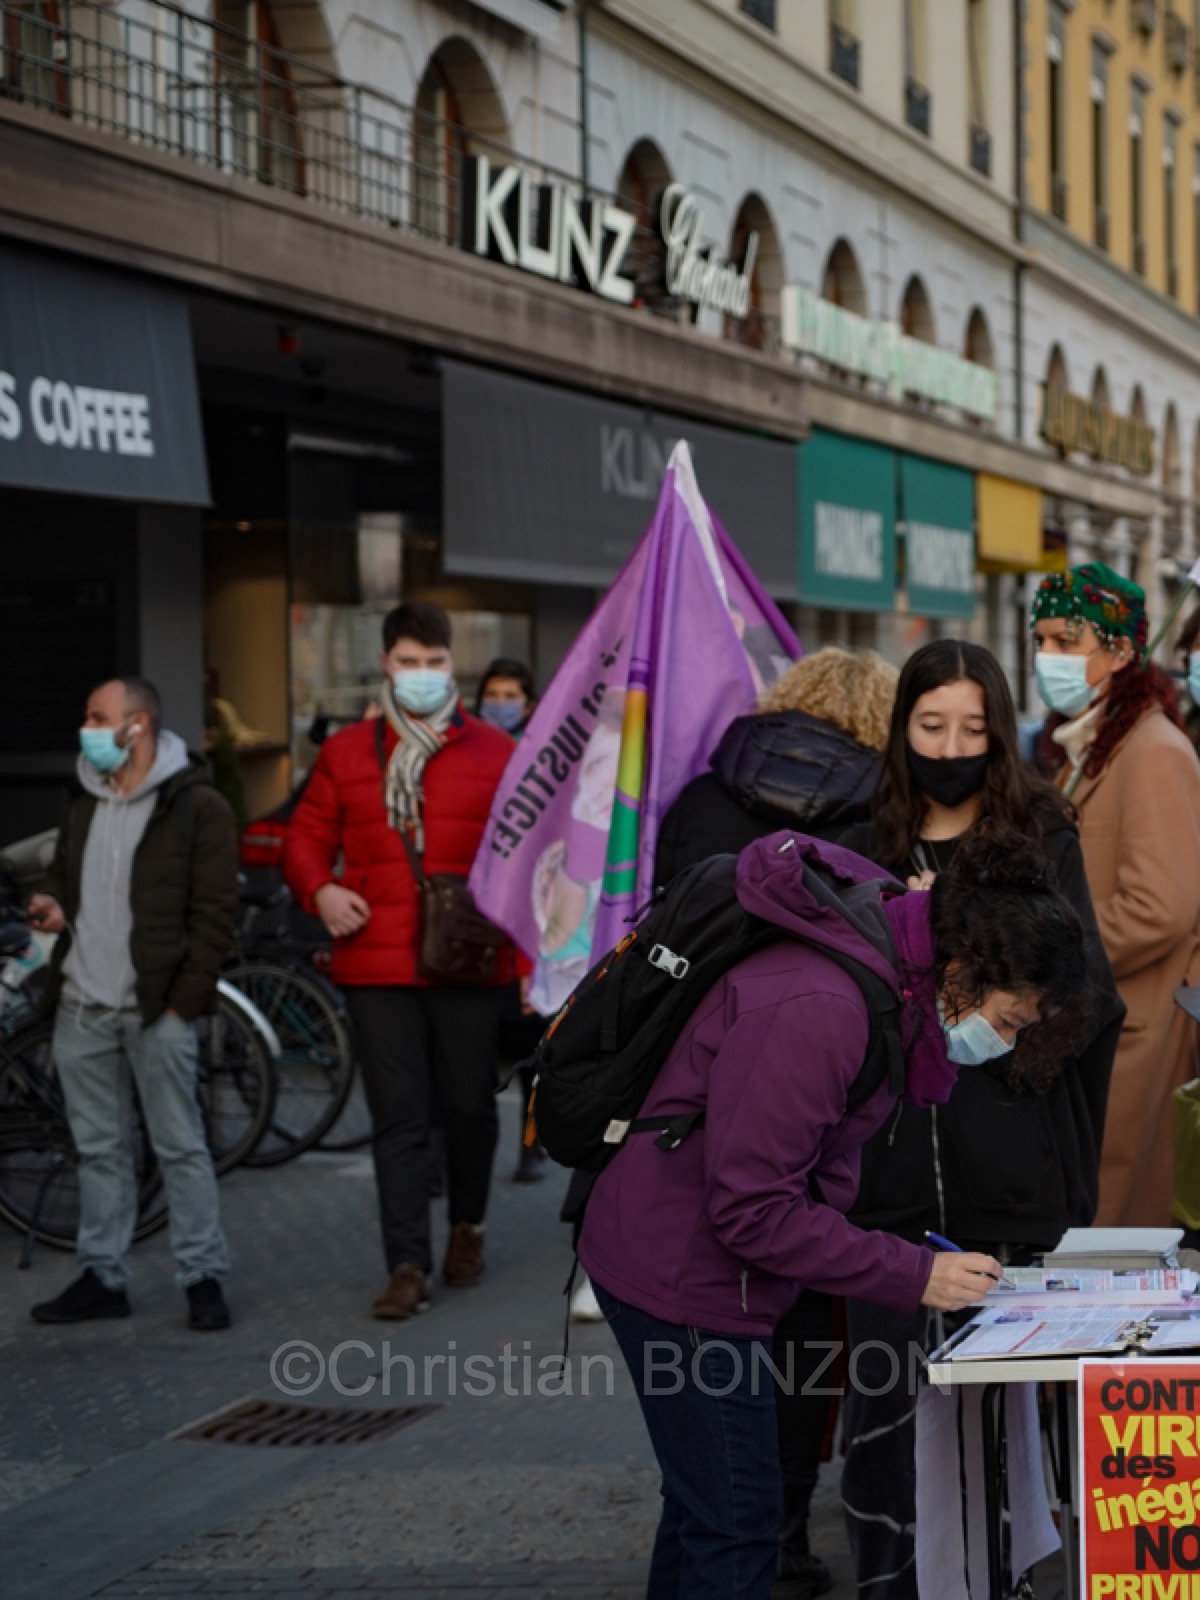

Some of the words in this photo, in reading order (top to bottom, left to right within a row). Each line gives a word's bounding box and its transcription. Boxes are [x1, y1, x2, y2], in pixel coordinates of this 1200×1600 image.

[477, 155, 637, 305] KUNZ
[30, 375, 154, 457] COFFEE
[602, 423, 694, 500] KUN
[1101, 1446, 1176, 1479] des
